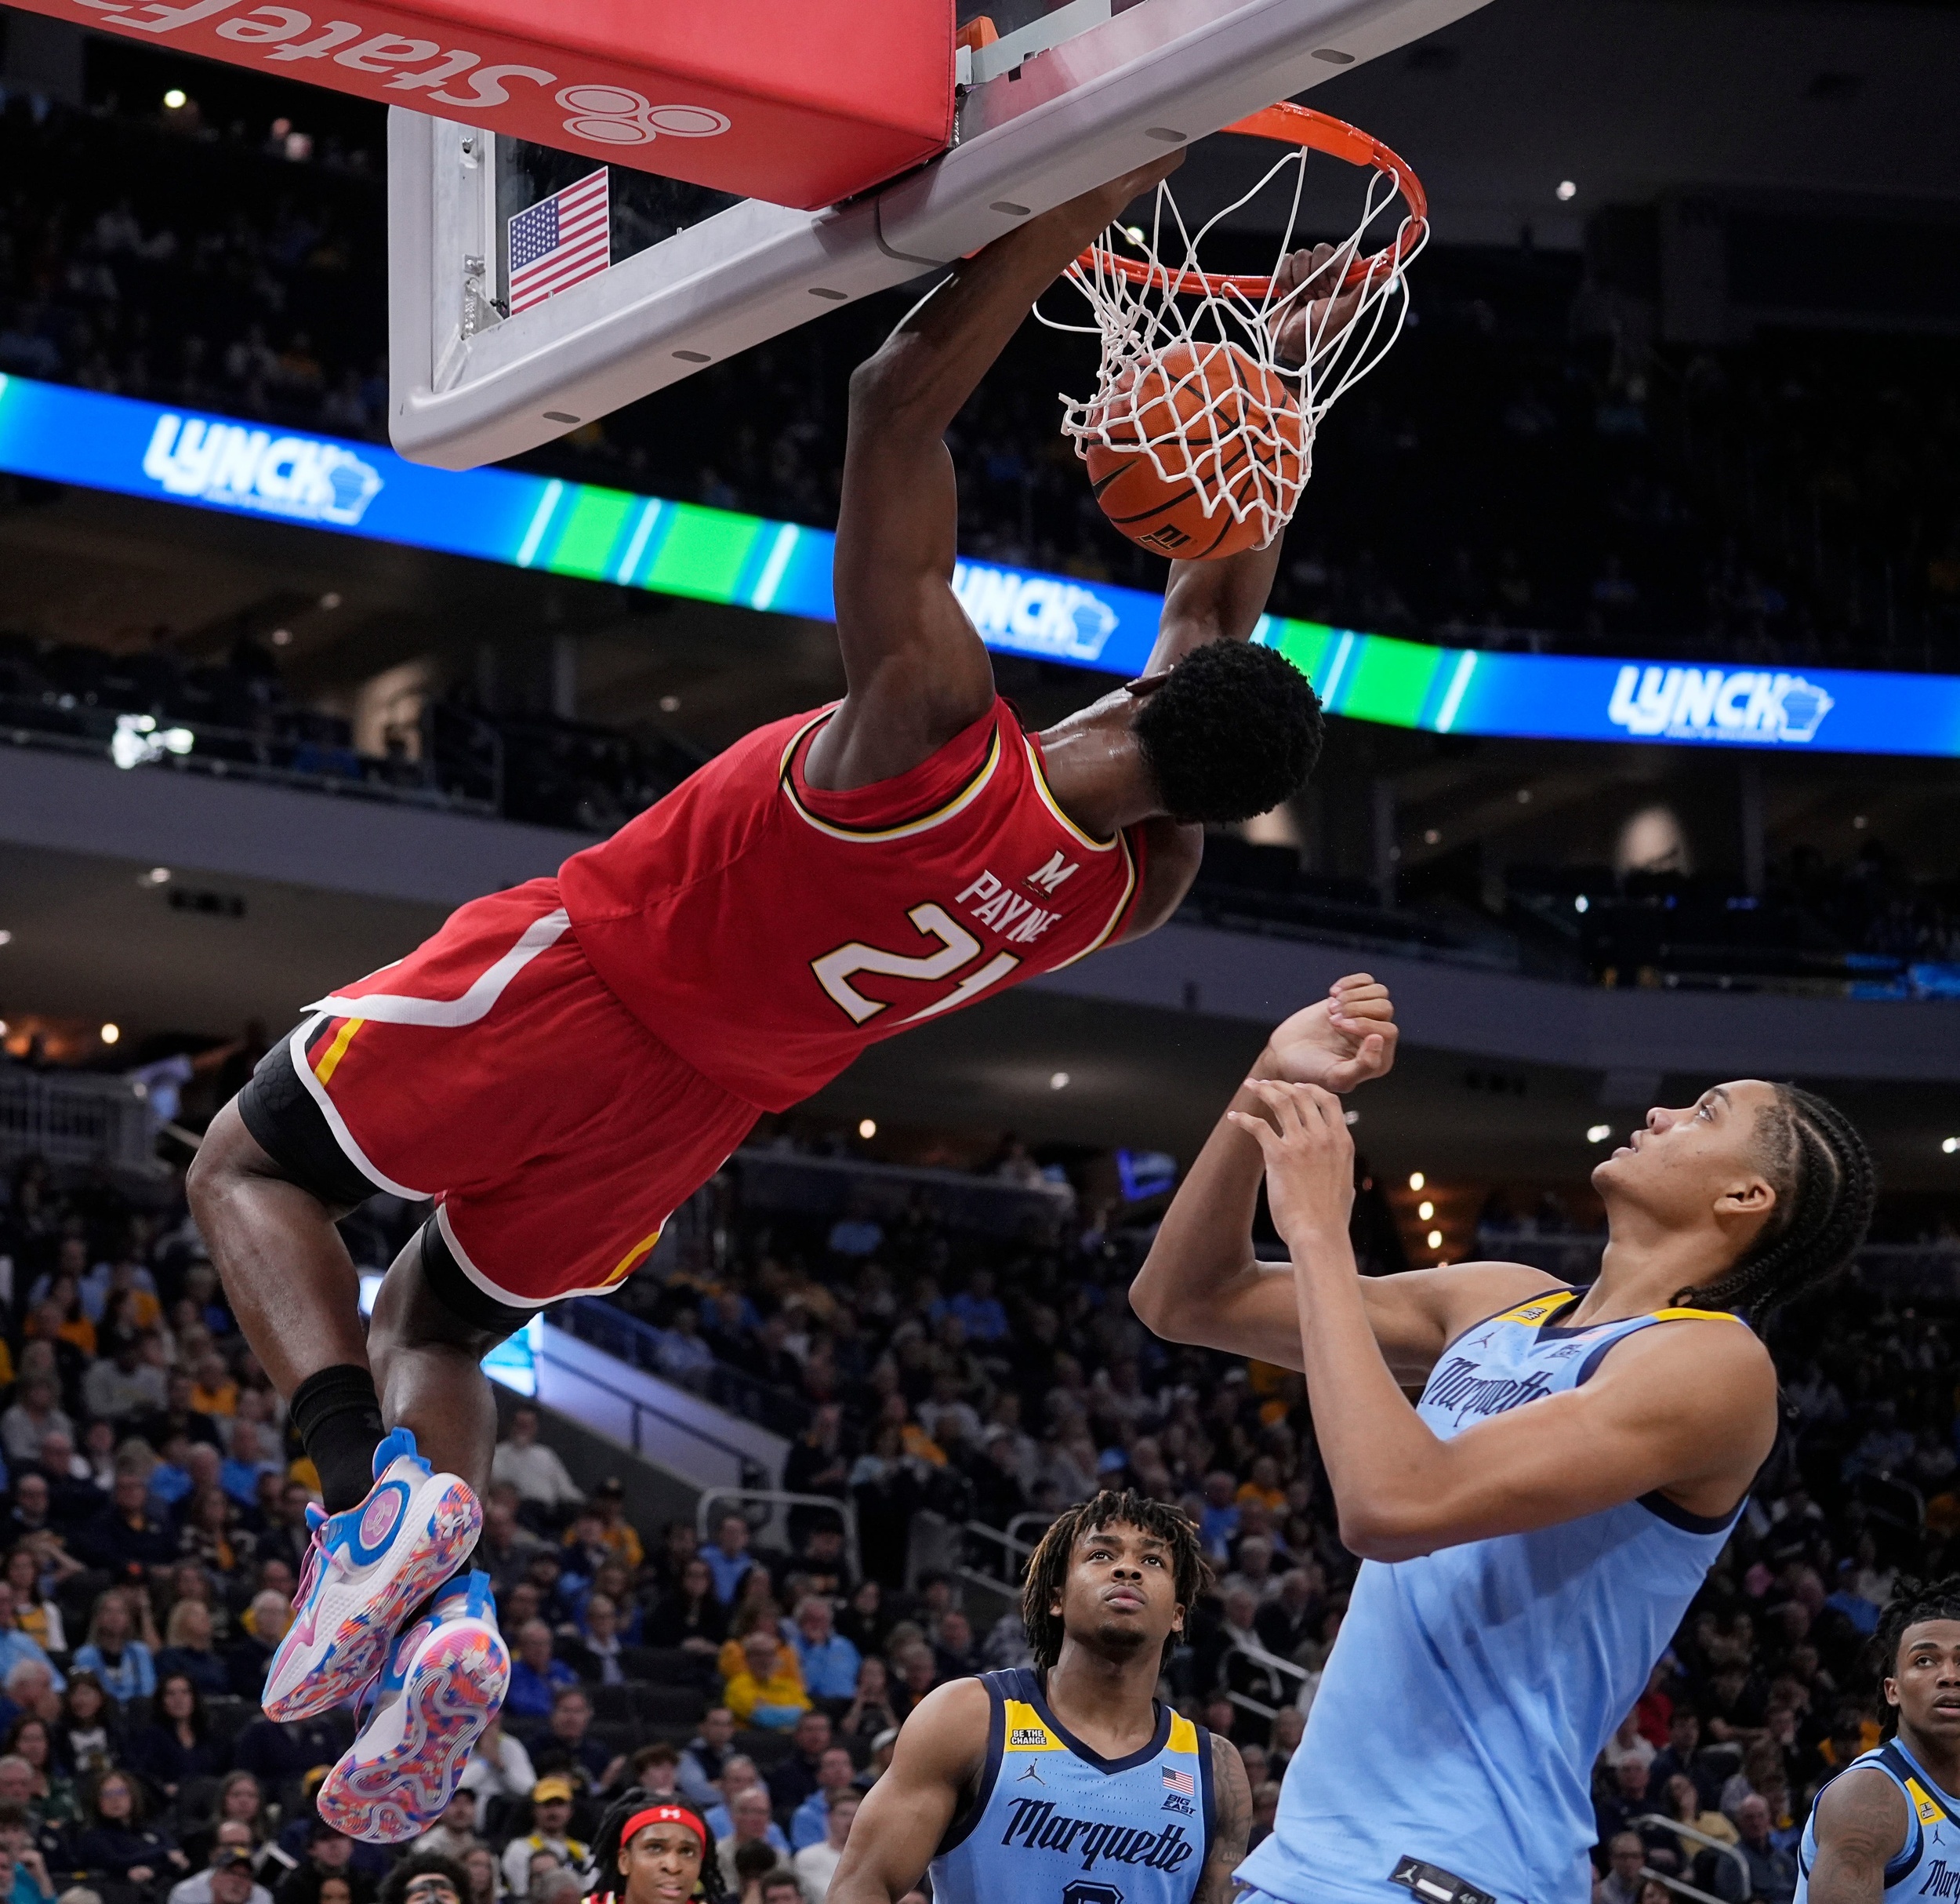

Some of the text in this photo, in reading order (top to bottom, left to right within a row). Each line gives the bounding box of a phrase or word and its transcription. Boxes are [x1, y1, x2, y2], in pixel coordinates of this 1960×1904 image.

[808, 899, 1023, 1029] 21
[1011, 1736, 1047, 1745] CHANGE
[1013, 1729, 1044, 1738] BE THE
[1167, 1793, 1192, 1807] BIG
[1163, 1800, 1196, 1815] EAST
[1000, 1797, 1193, 1873] Marquette
